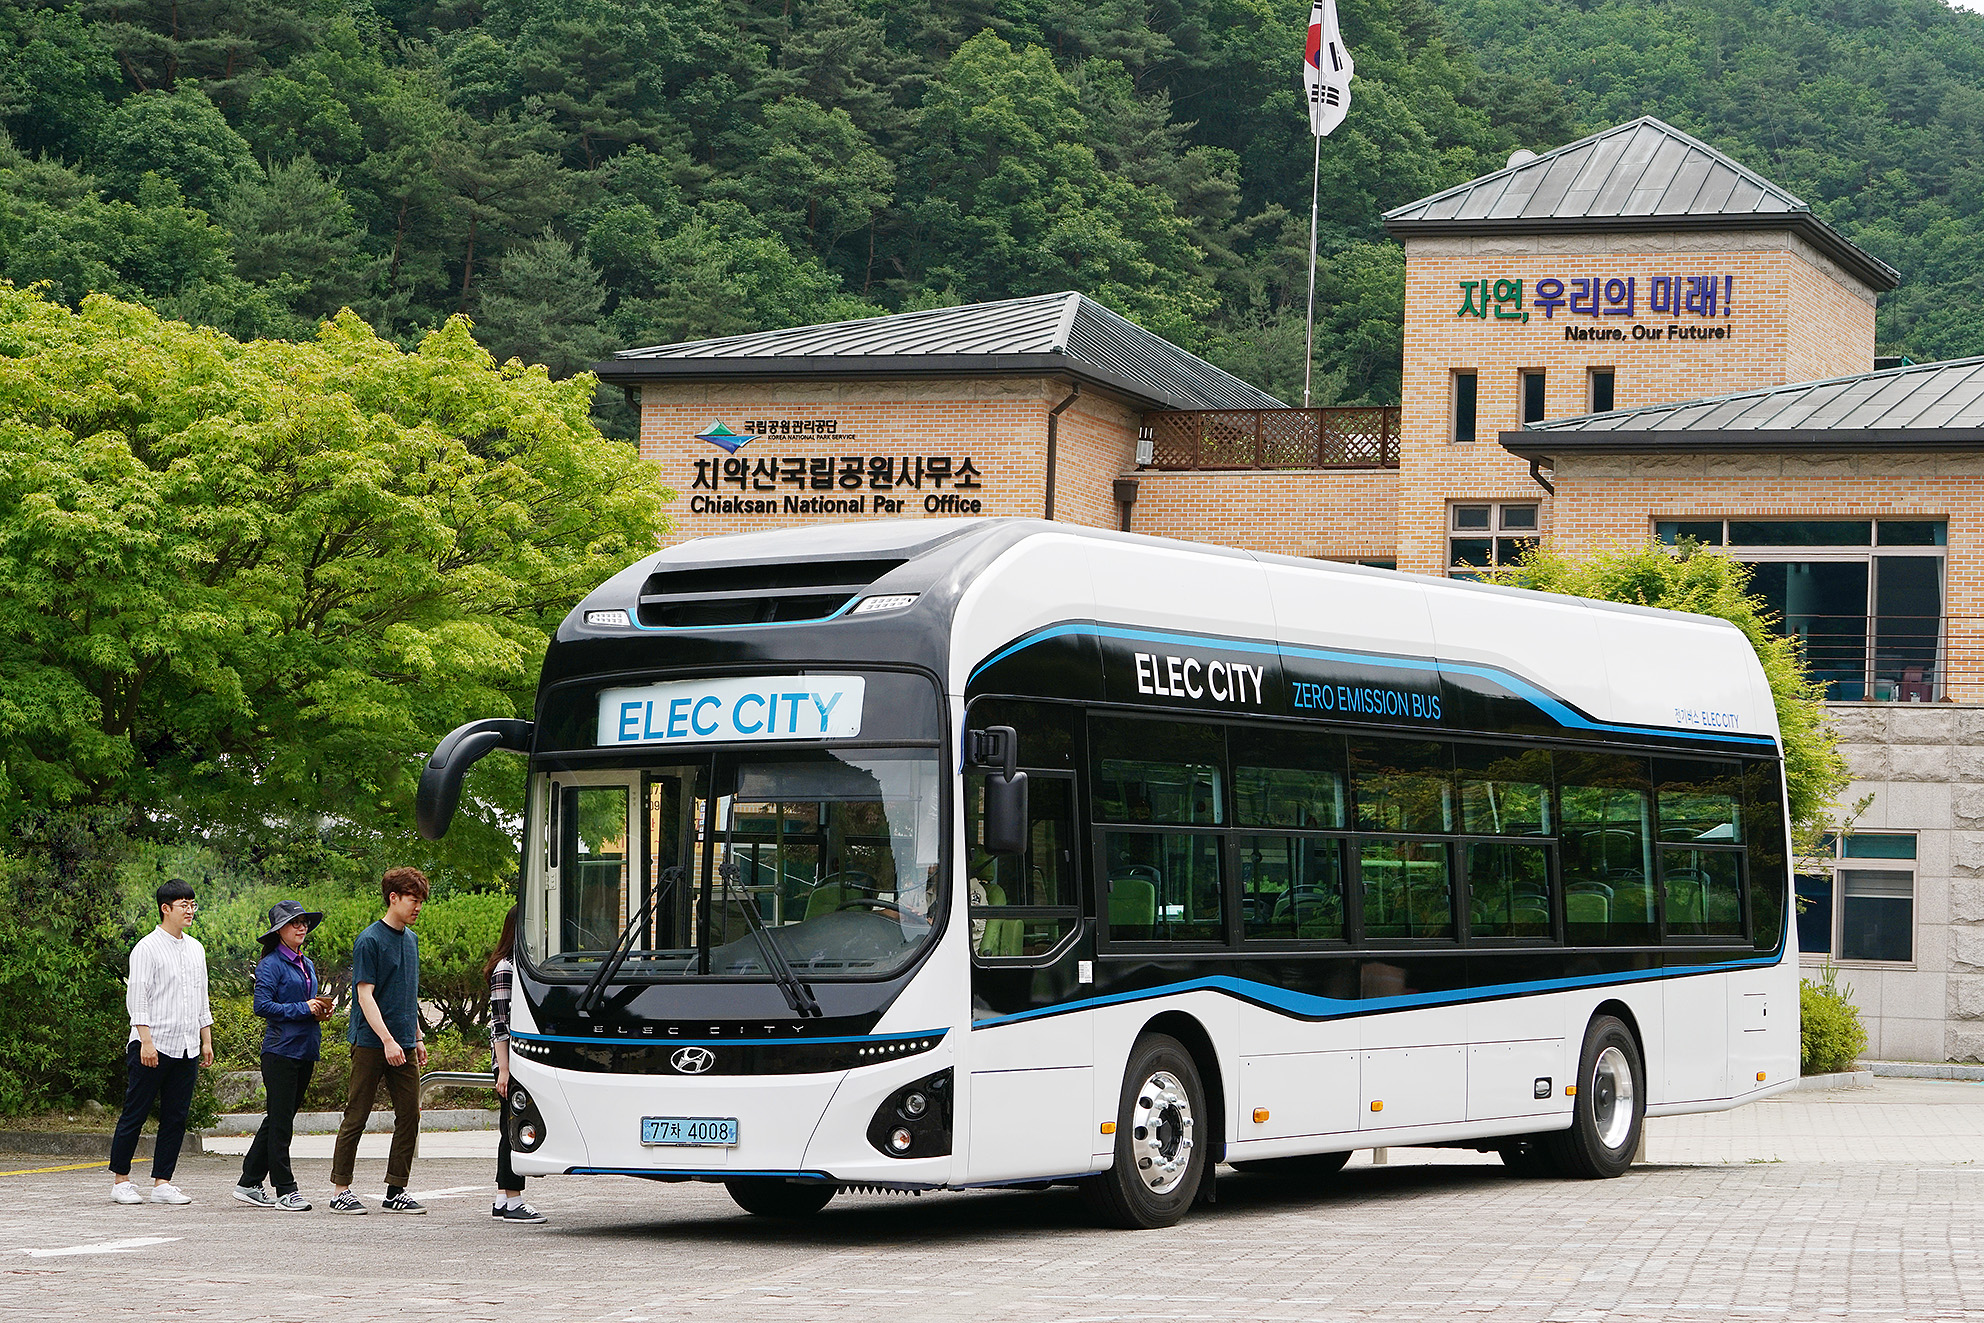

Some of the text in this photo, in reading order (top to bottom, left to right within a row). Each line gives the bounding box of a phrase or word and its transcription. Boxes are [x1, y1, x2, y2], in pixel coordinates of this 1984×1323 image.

[1457, 275, 1733, 323] 자연, 우리의 미래!
[1565, 324, 1732, 341] Nature, Our Future!
[744, 420, 838, 434] 국립공원관리공단
[691, 456, 982, 490] 치악산국립공원사무소
[690, 494, 982, 514] Chiaksan National Par Office
[1134, 652, 1264, 704] ELEC CITY
[1292, 681, 1441, 720] ZERO EMISSION BUS
[618, 692, 844, 742] ELEC CITY
[593, 1025, 805, 1035] ELEC CITY
[650, 1122, 728, 1140] 77차 4008
